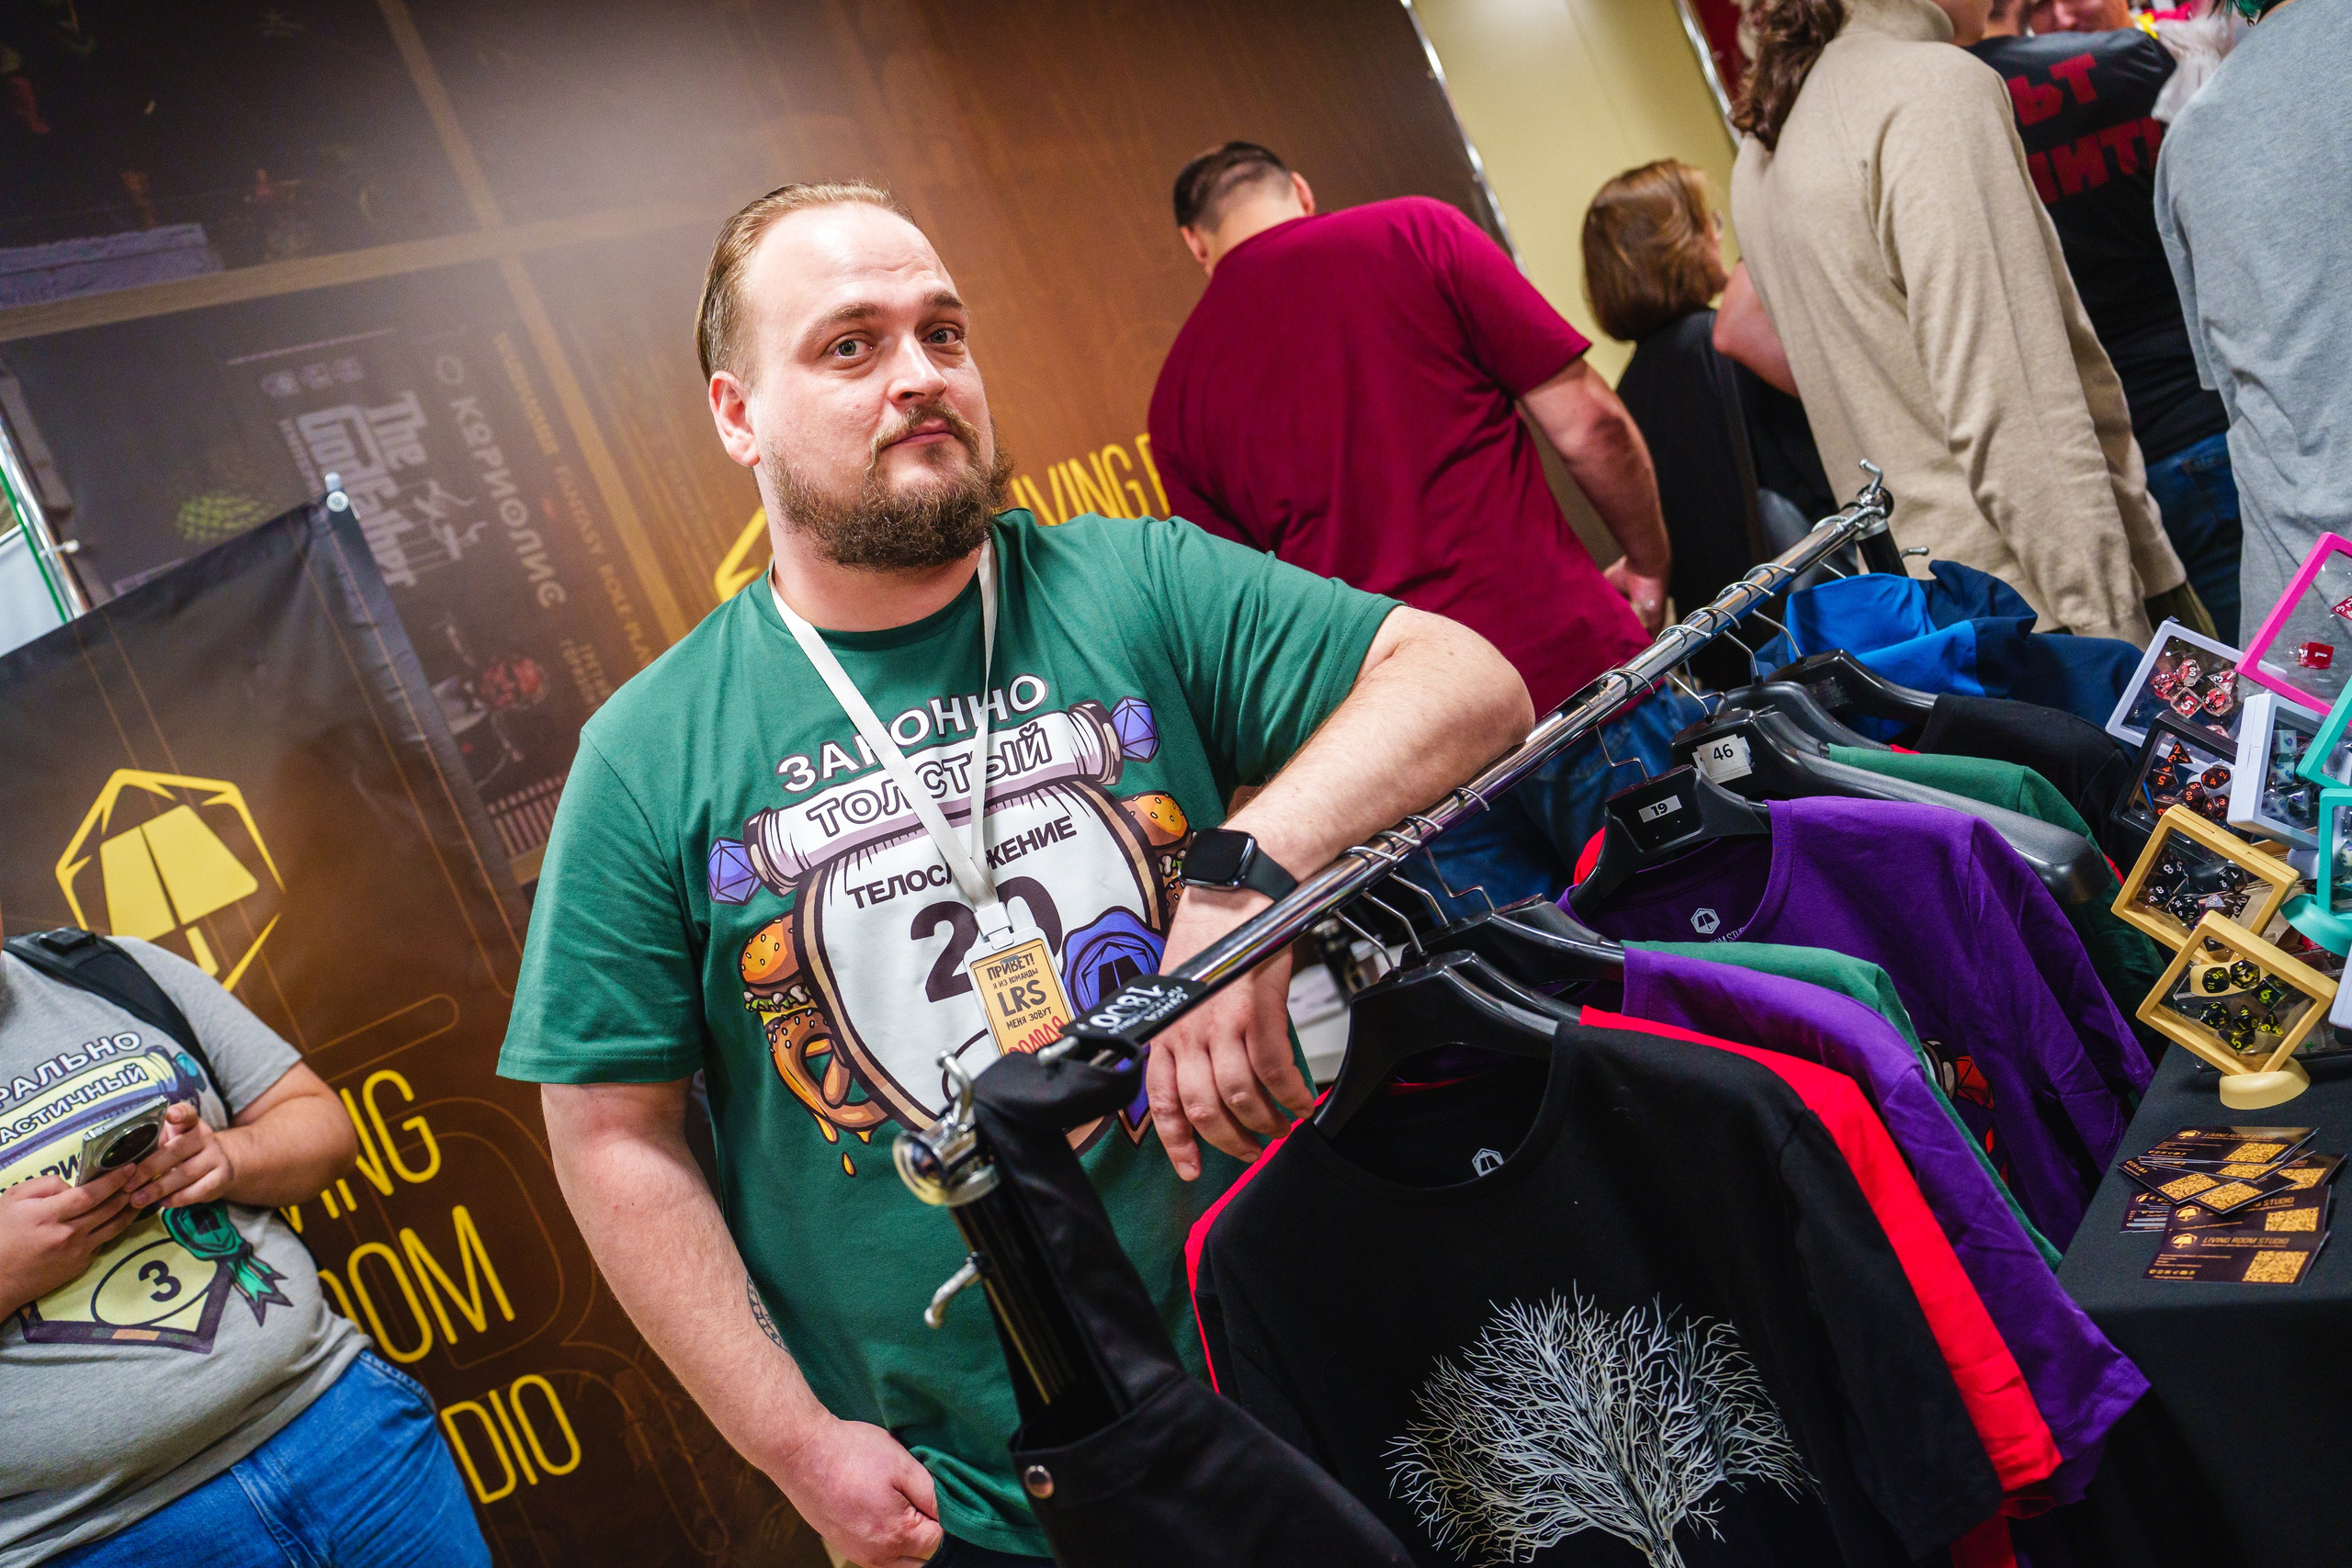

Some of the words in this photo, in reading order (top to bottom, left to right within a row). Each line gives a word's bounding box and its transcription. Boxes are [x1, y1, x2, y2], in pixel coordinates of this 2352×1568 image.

[367, 389, 428, 470] The
[2180, 699, 2194, 711] 5
[1713, 743, 1734, 761] 46
[2174, 745, 2181, 754] 2
[2210, 777, 2217, 786] 4
[1650, 802, 1668, 817] 19
[846, 815, 1078, 909] ТЕЛОСЖЕНИЕ
[2163, 863, 2174, 874] 8
[2155, 886, 2165, 895] 8
[910, 875, 1063, 1003] 20
[987, 953, 1035, 981] ПРИВЕТ!
[993, 982, 998, 990] Я
[999, 980, 1008, 988] ИЗ
[1010, 967, 1039, 985] КОМАНДЫ
[997, 979, 1046, 1018] LRS
[1090, 984, 1165, 1028] 1800
[1006, 1015, 1027, 1031] МЕНЯ
[1028, 1007, 1052, 1021] ЗОВУТ
[2261, 1023, 2271, 1032] 3
[2231, 1038, 2242, 1049] 5
[0, 1063, 149, 1146] АСТИЧНЫЙ
[138, 1259, 182, 1303] 3
